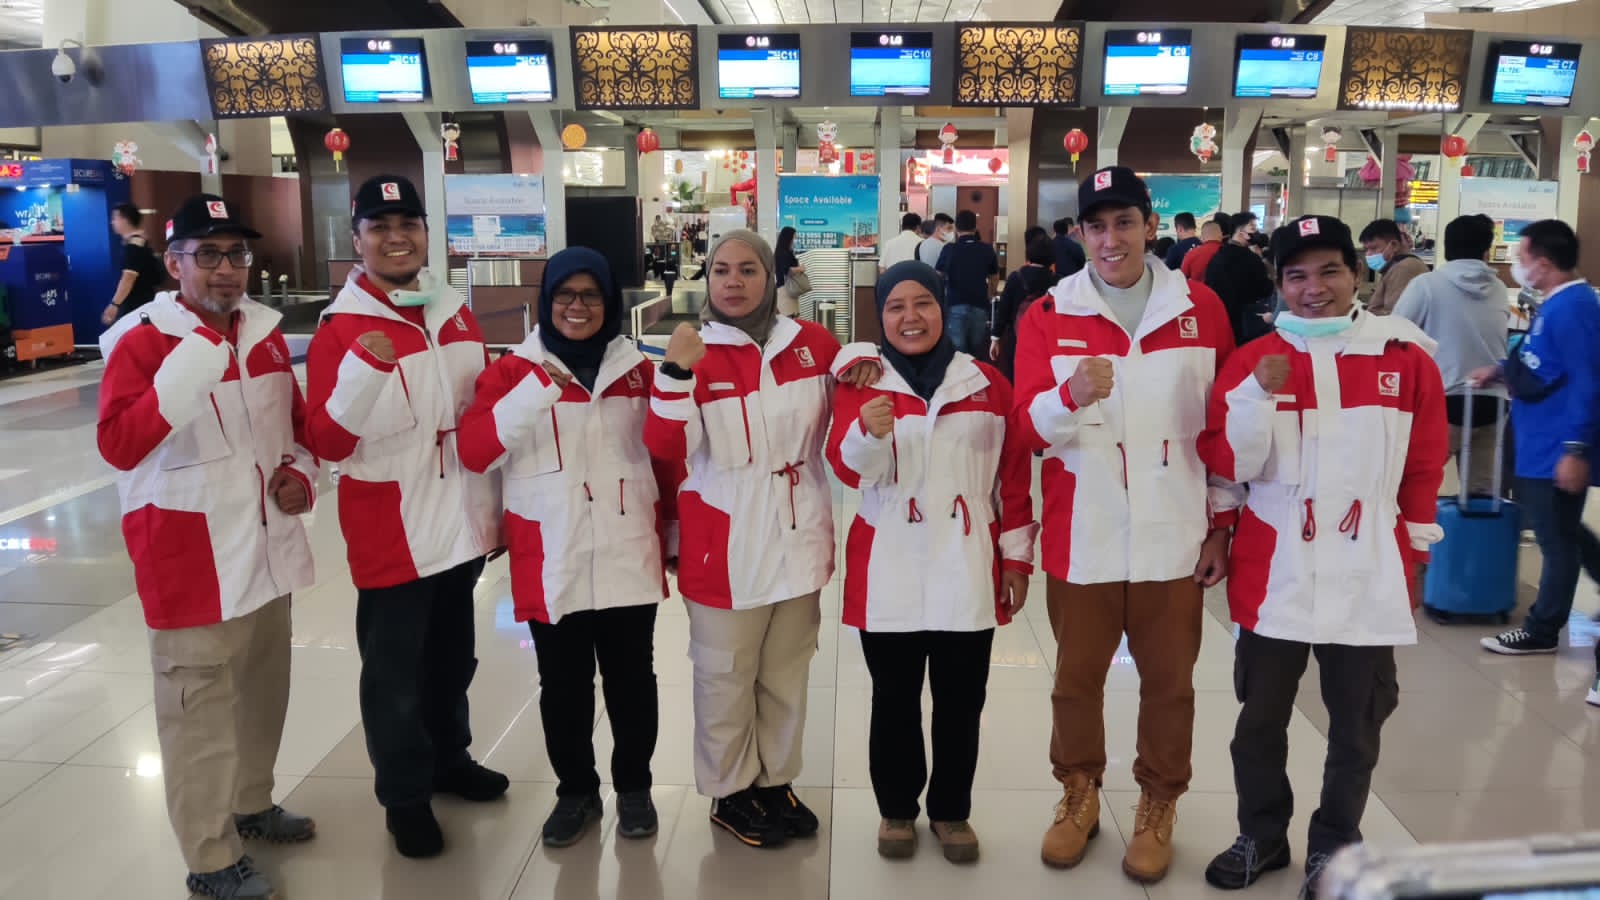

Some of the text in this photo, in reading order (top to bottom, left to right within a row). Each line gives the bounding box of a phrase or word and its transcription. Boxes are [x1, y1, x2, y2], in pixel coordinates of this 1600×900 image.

[756, 37, 770, 46] LG
[889, 35, 903, 45] LG
[1147, 32, 1161, 43] LG
[1281, 37, 1296, 48] LG
[378, 40, 392, 50] LG
[504, 43, 518, 53] LG
[1539, 45, 1553, 55] LG
[780, 51, 798, 60] C11
[912, 50, 931, 59] C10
[1561, 59, 1574, 69] C7
[784, 195, 852, 206] Space Available
